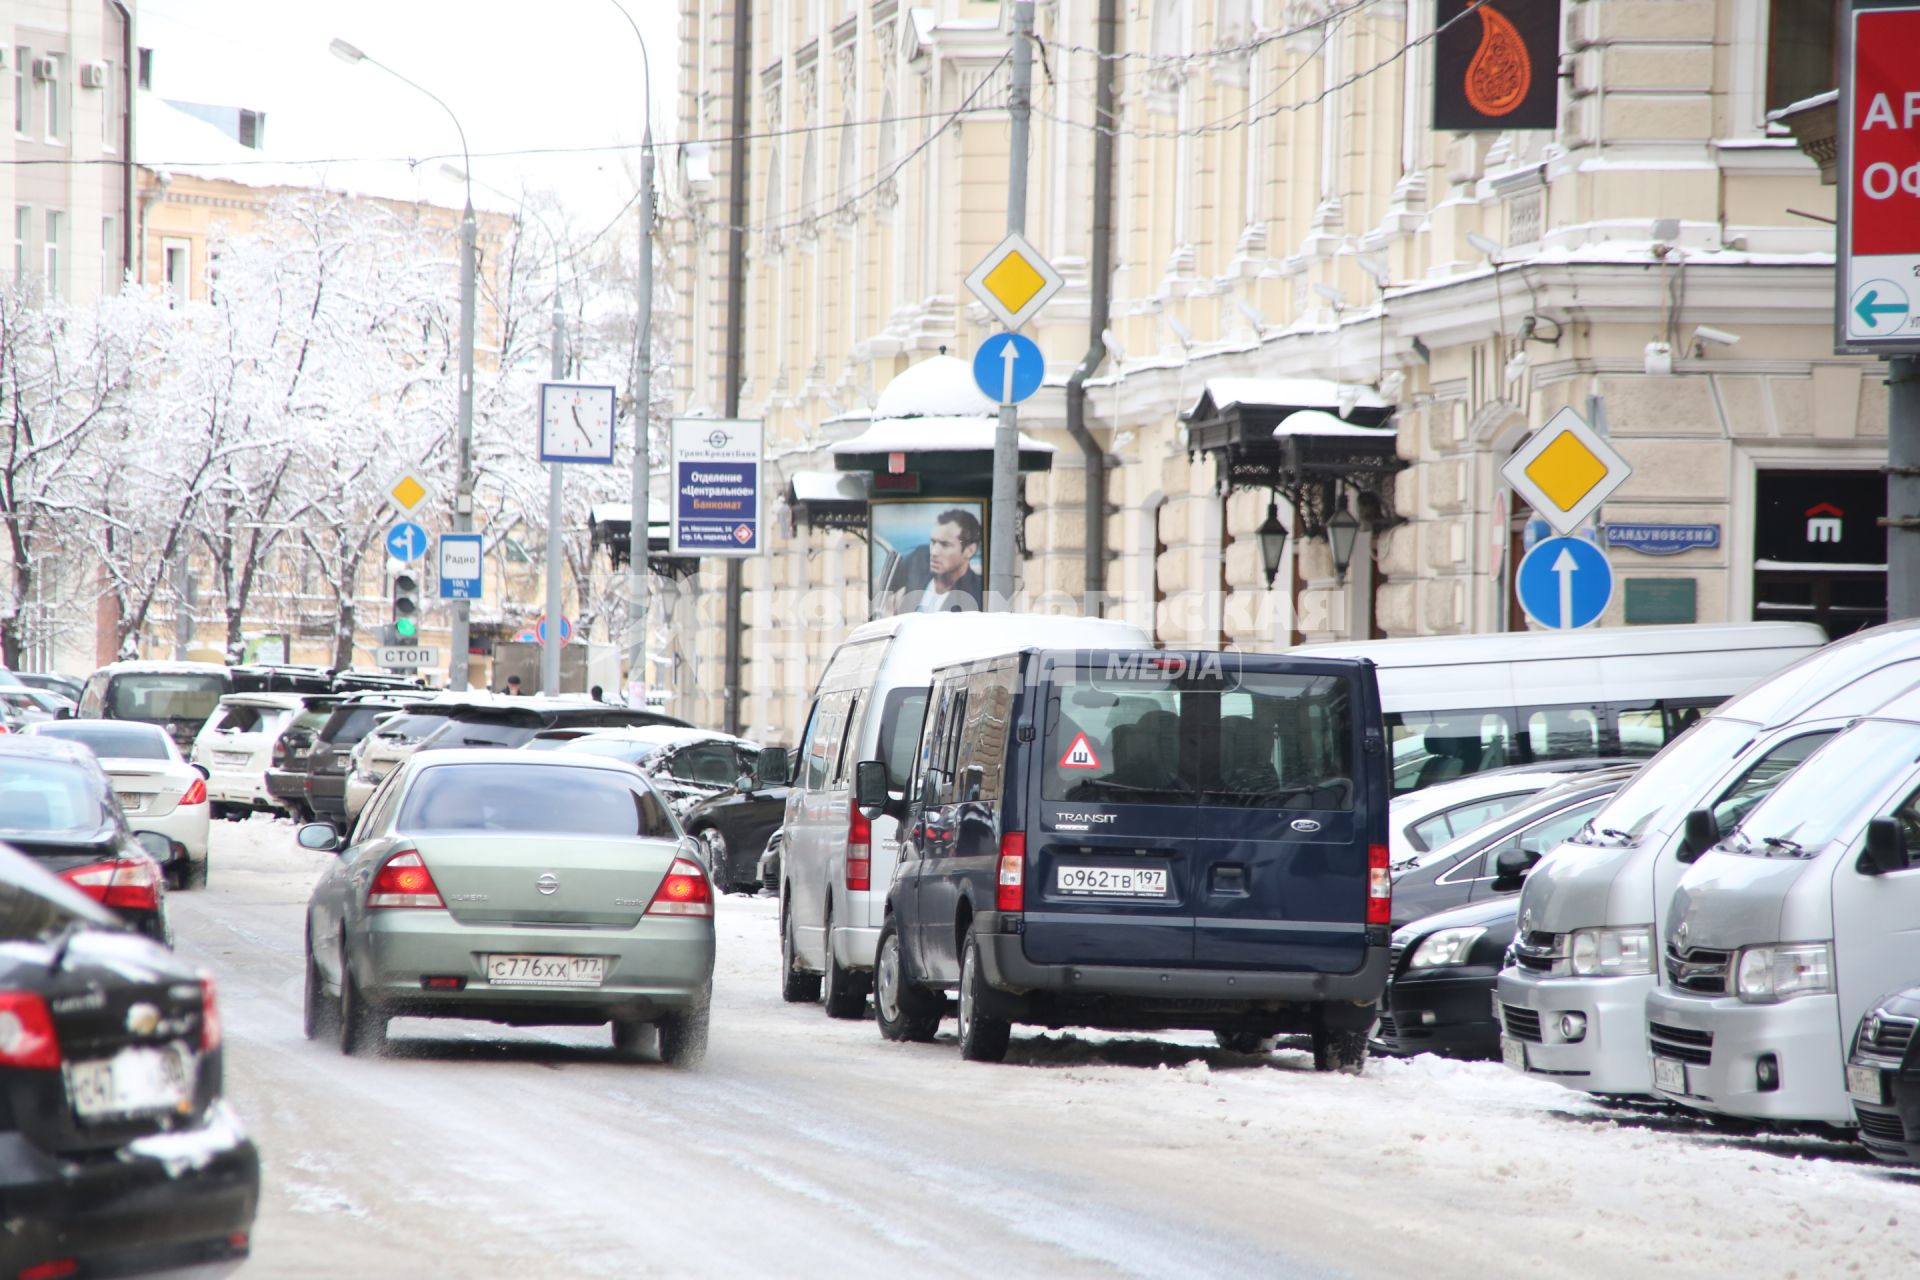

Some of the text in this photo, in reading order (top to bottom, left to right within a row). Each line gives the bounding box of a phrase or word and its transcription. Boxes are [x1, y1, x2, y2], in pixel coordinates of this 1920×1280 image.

[691, 471, 743, 484] Отделение
[681, 485, 755, 498] «Центральное»
[693, 498, 742, 511] Банкомат
[1608, 528, 1713, 541] САНДУНОВСКИЙ
[445, 553, 476, 565] Радио
[385, 650, 429, 662] СТОП
[1073, 751, 1088, 763] Ш
[1056, 812, 1117, 824] TRANSIT
[1136, 872, 1162, 885] 197
[572, 959, 599, 973] 177
